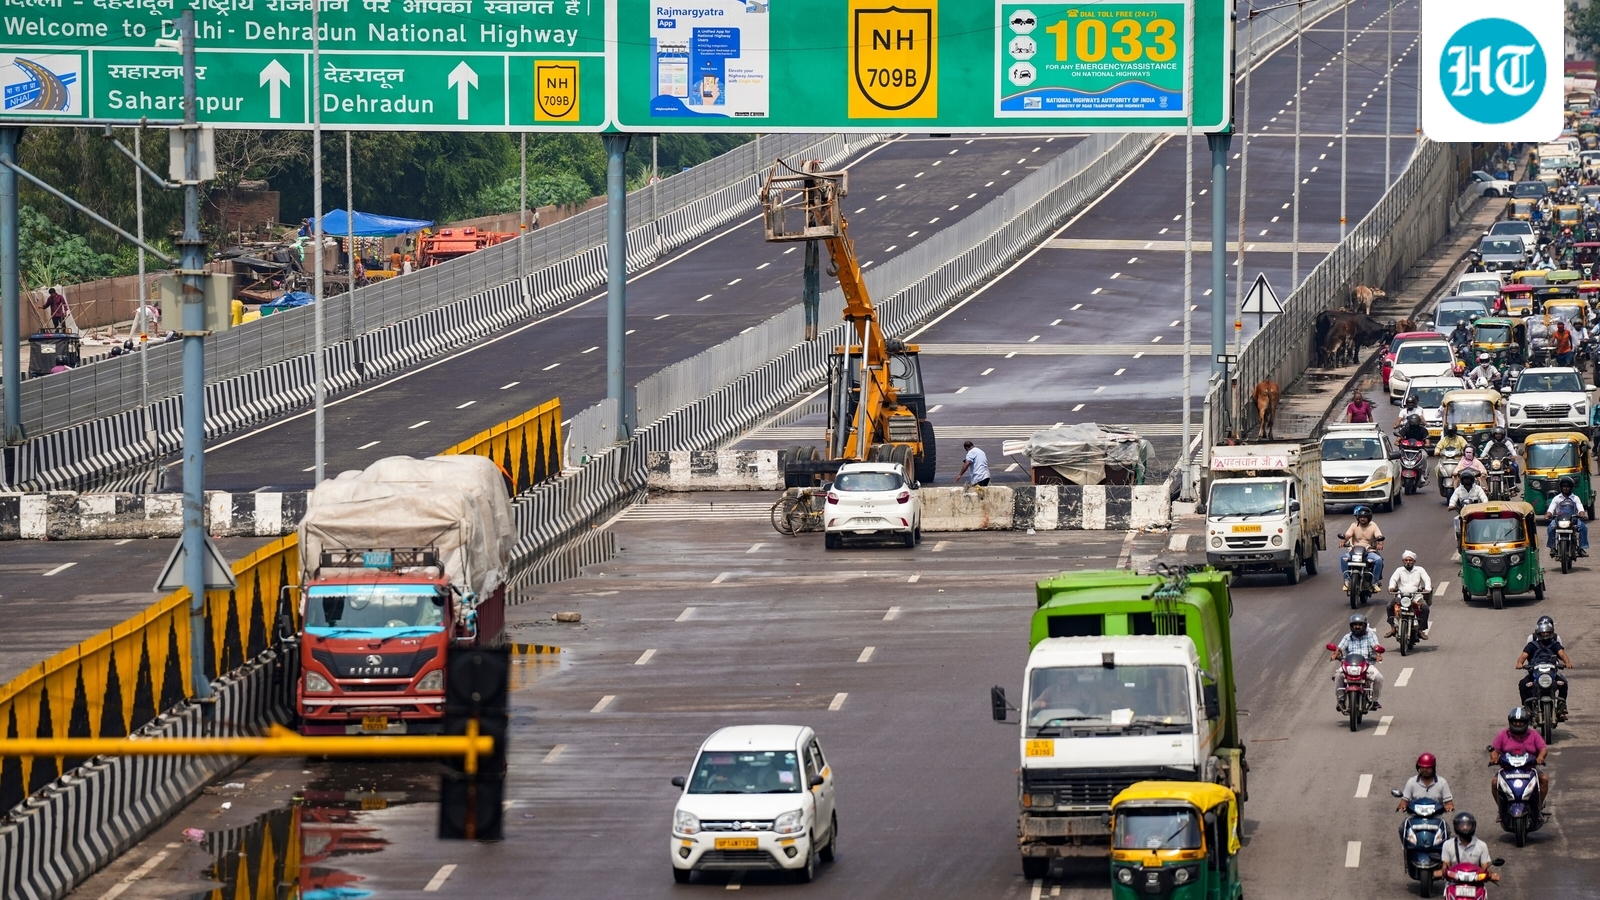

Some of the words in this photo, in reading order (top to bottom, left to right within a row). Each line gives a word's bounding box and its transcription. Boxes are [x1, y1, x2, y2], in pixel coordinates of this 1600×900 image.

[94, 0, 174, 15] दहरादून
[362, 0, 391, 12] पर
[403, 0, 472, 14] आपका
[484, 0, 554, 14] स्वागत
[656, 6, 724, 18] Rajmargyatra
[4, 17, 108, 37] Welcome
[122, 20, 146, 38] to
[161, 20, 222, 39] Dlhi
[246, 22, 356, 41] Dehradun
[368, 24, 466, 42] National
[480, 24, 578, 47] Highway
[873, 29, 913, 50] NH
[1046, 19, 1177, 62] 1033
[108, 65, 208, 82] सहारनर
[324, 62, 404, 88] देहरादून
[867, 68, 916, 87] 709B
[546, 78, 568, 89] NH
[10, 93, 30, 106] NHAI
[108, 90, 244, 114] Saharanpur
[324, 94, 434, 113] Dehradun
[544, 96, 570, 106] 709B
